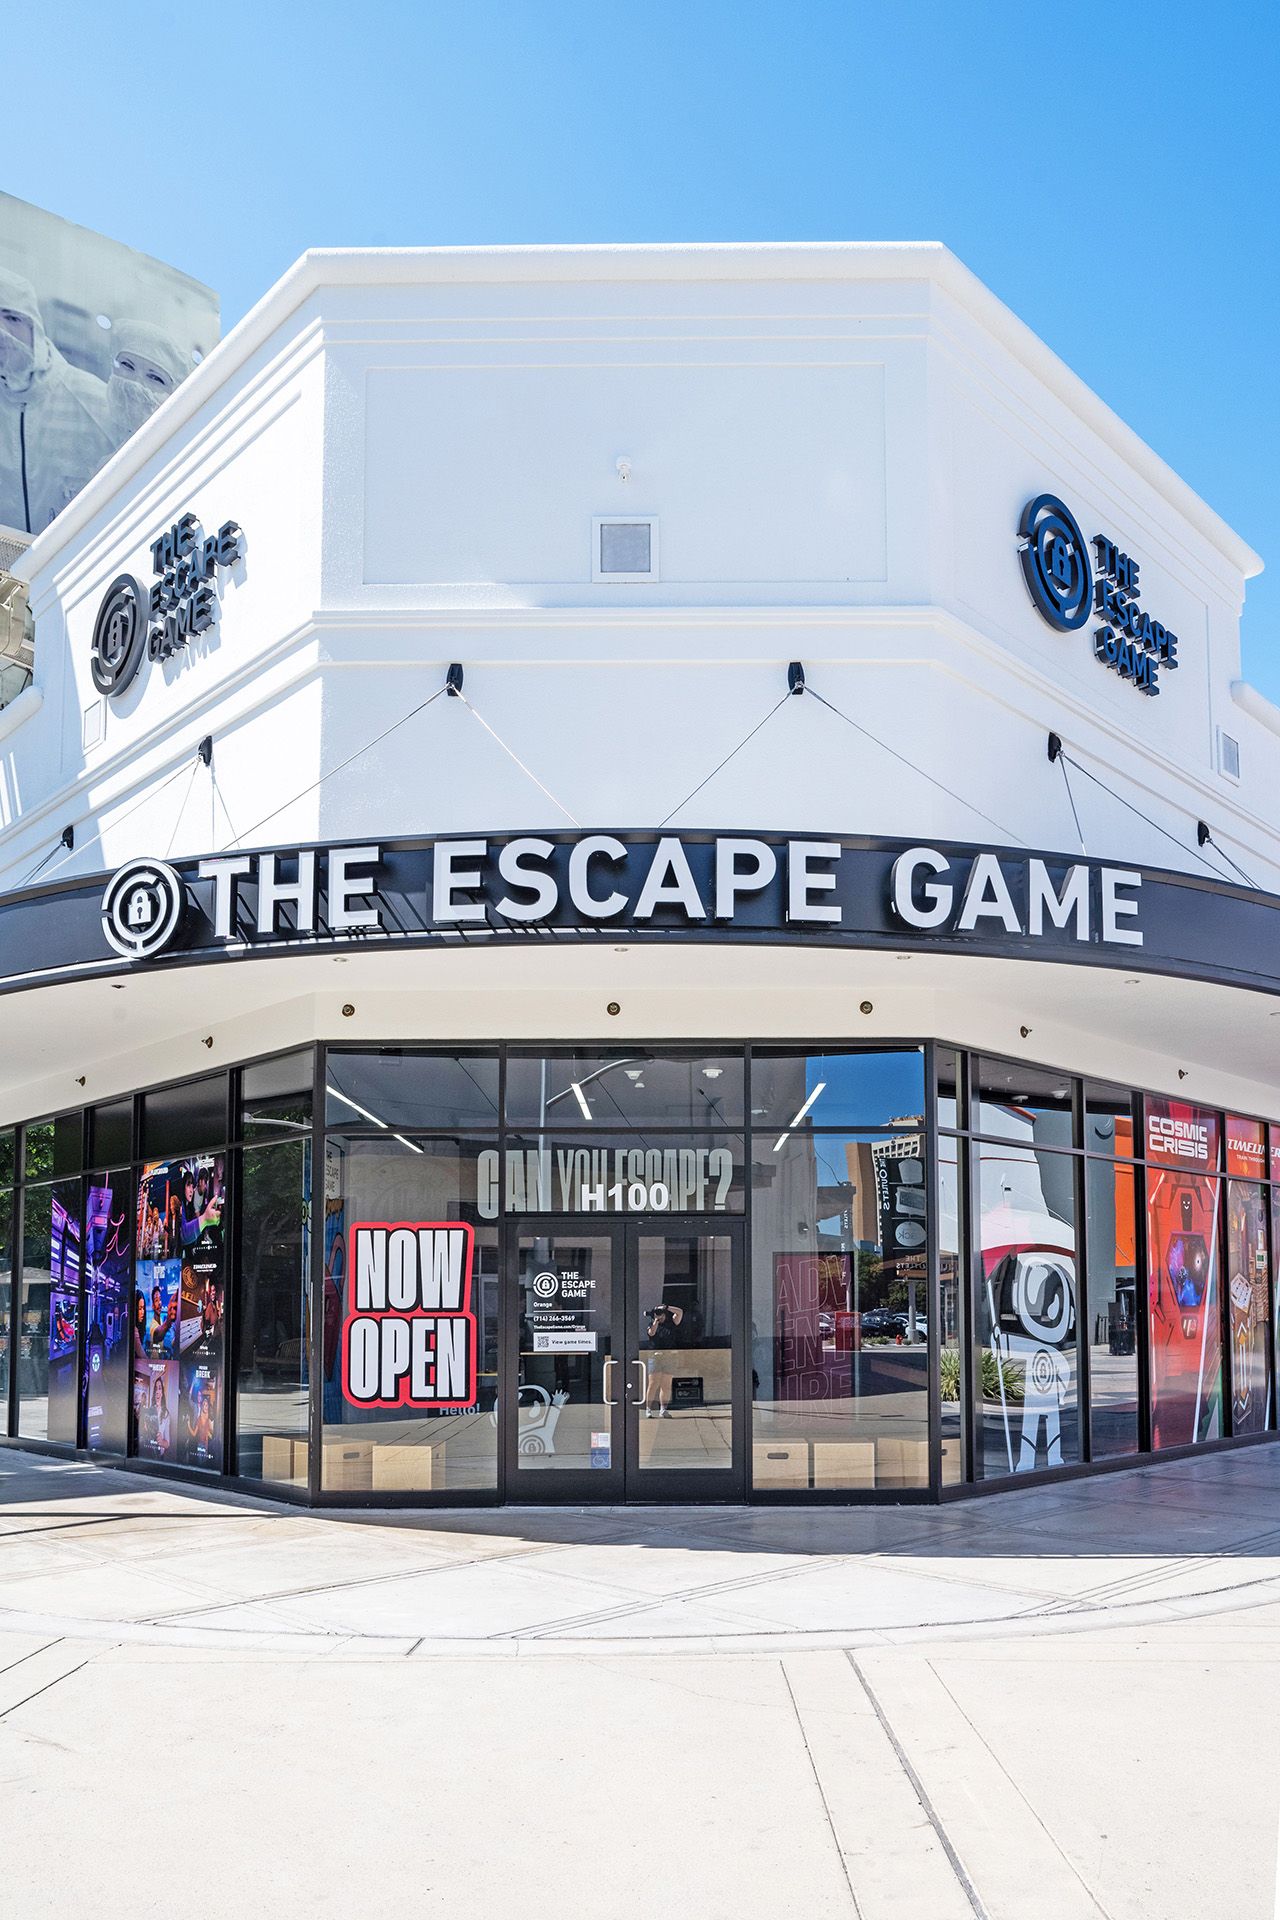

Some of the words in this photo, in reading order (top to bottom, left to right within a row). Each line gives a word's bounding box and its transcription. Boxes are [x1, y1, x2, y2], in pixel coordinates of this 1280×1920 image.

[150, 512, 199, 576] THE
[150, 520, 240, 622] ESCAPE
[1092, 533, 1141, 600] THE
[148, 587, 215, 664] GAME
[1094, 578, 1178, 670] ESCAPE
[1095, 625, 1160, 697] GAME
[198, 846, 382, 938] THE
[433, 835, 842, 924] ESCAPE
[893, 847, 1144, 947] GAME
[1148, 1115, 1208, 1143] COSMIC
[1149, 1133, 1209, 1160] CRISIS
[477, 1150, 552, 1219] CAN
[581, 1182, 670, 1212] H100
[356, 1229, 465, 1310] NOW
[561, 1271, 580, 1280] THE
[561, 1280, 597, 1289] ESCAPE
[561, 1289, 588, 1298] GAME
[349, 1317, 467, 1399] OPEN
[439, 1402, 481, 1416] Hello!
